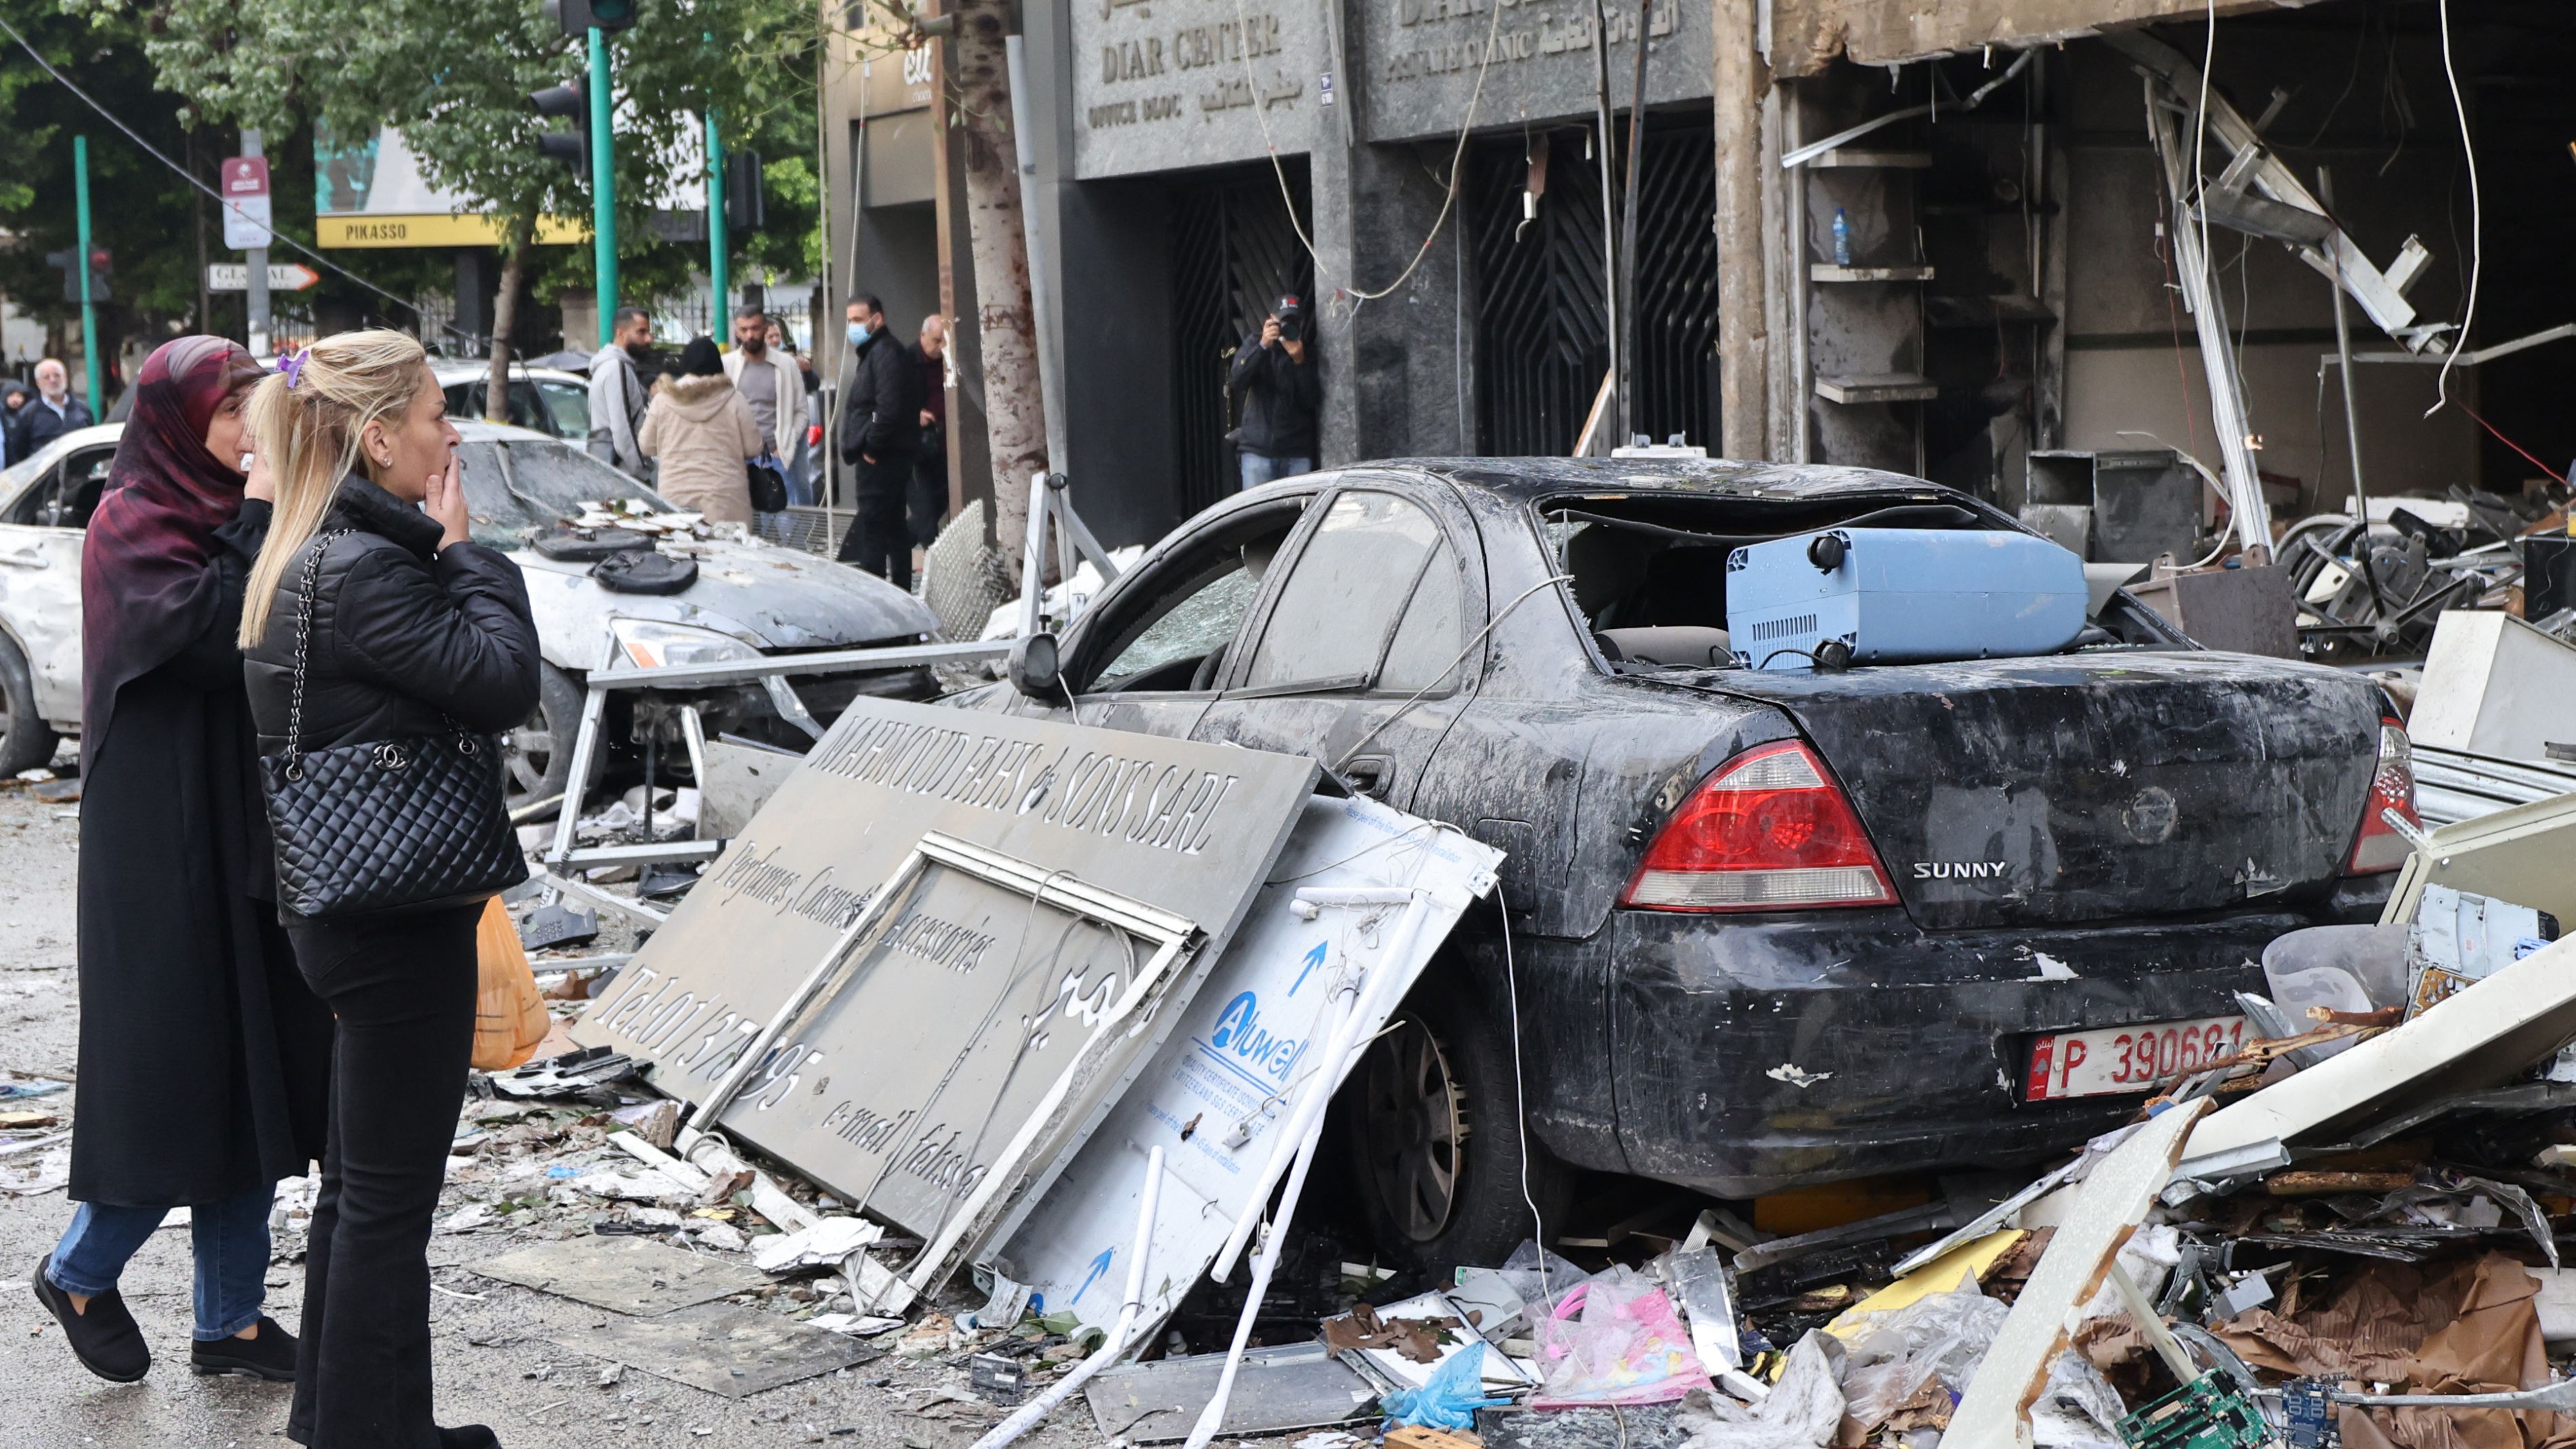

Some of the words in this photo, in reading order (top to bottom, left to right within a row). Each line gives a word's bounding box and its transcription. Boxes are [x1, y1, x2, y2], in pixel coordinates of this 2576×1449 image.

[1102, 37, 1165, 84] DIAR
[1172, 15, 1281, 70] CENTER
[346, 224, 406, 241] PIKASSO
[809, 715, 971, 795] MAHMOUD
[941, 736, 1045, 812] FAHS
[1043, 752, 1154, 837] SONS
[1125, 764, 1240, 855] SARL
[1914, 861, 2005, 878] SUNNY
[1212, 991, 1309, 1082] Aluwell
[2036, 1038, 2054, 1050] لبنان
[1204, 1070, 1239, 1098] CERTIFICATE
[2060, 1040, 2087, 1088] P
[1171, 1069, 1213, 1101] SWITZERLAND
[1211, 1095, 1226, 1110] SGS
[822, 1101, 916, 1154] e-mail
